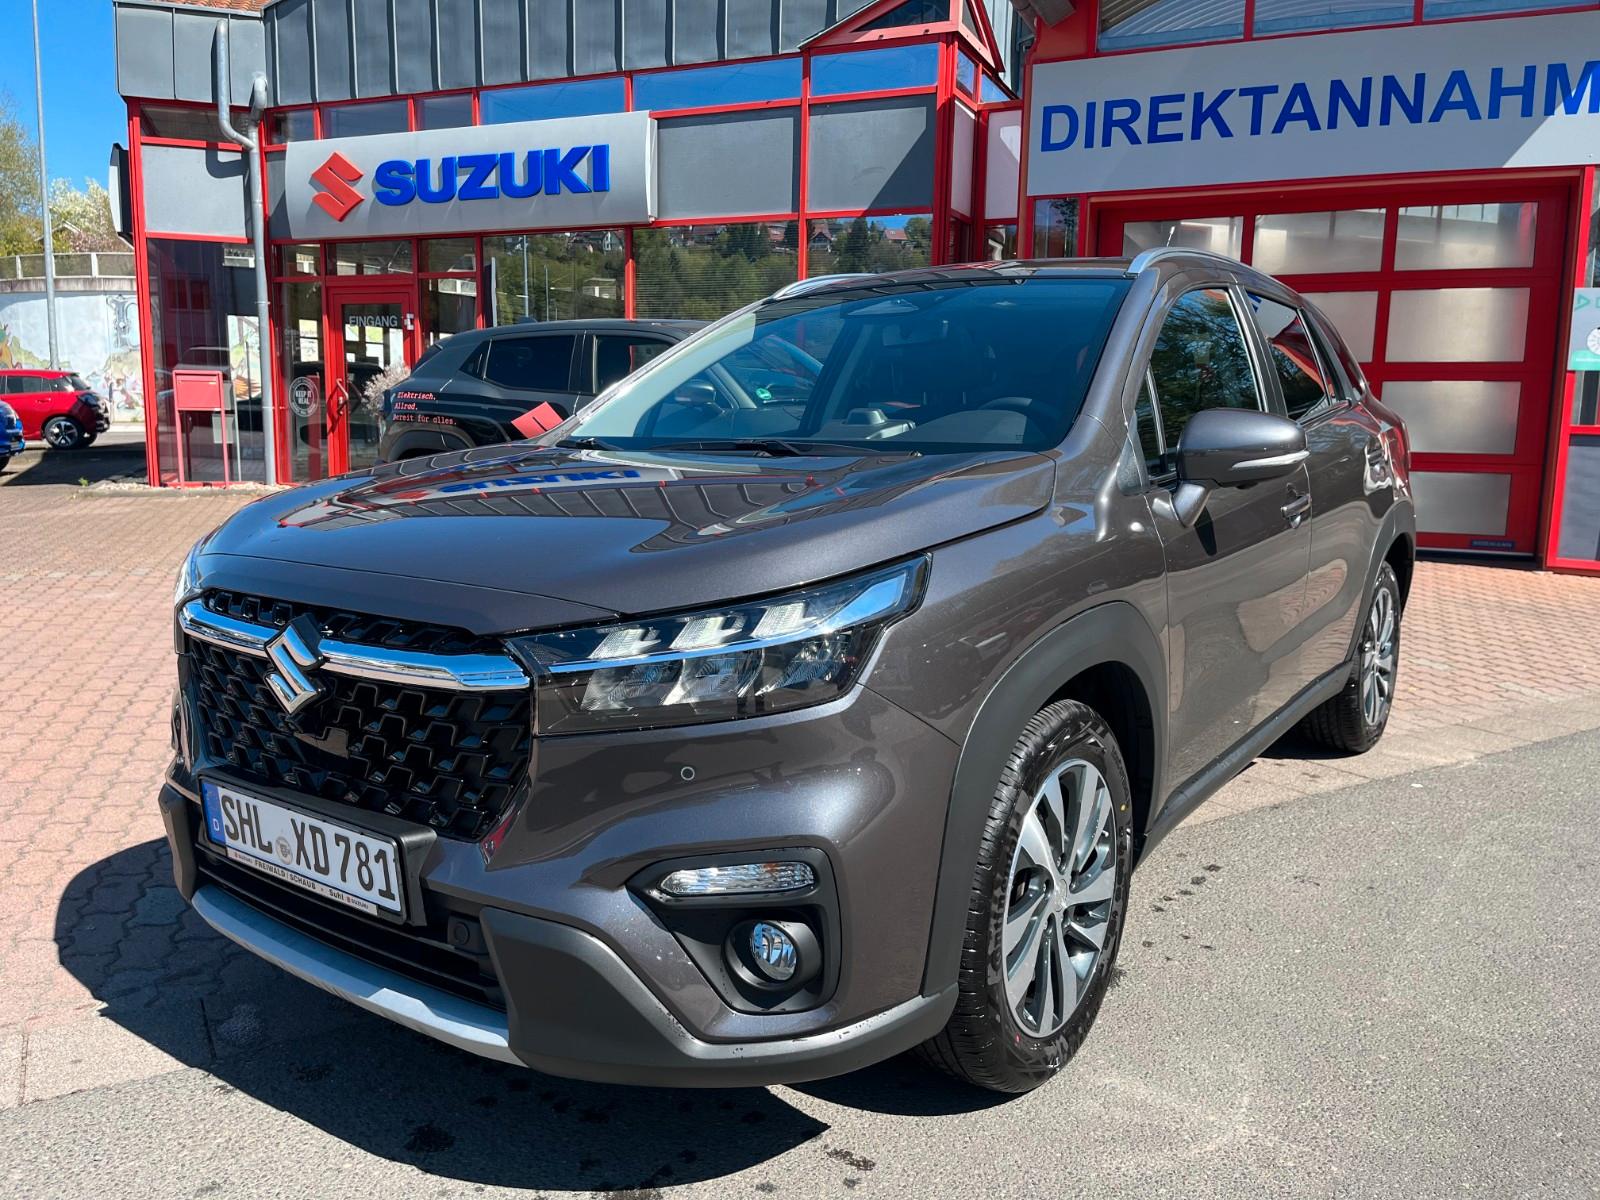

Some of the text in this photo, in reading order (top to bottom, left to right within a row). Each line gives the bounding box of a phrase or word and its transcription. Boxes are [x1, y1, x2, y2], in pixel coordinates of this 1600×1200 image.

[1039, 59, 1600, 152] DIREKTANNAHM
[374, 143, 610, 207] SUZUKI
[348, 315, 398, 327] EINGANG
[392, 413, 415, 421] Bereit
[417, 414, 430, 423] für
[213, 818, 220, 831] D
[221, 795, 273, 855] SHL
